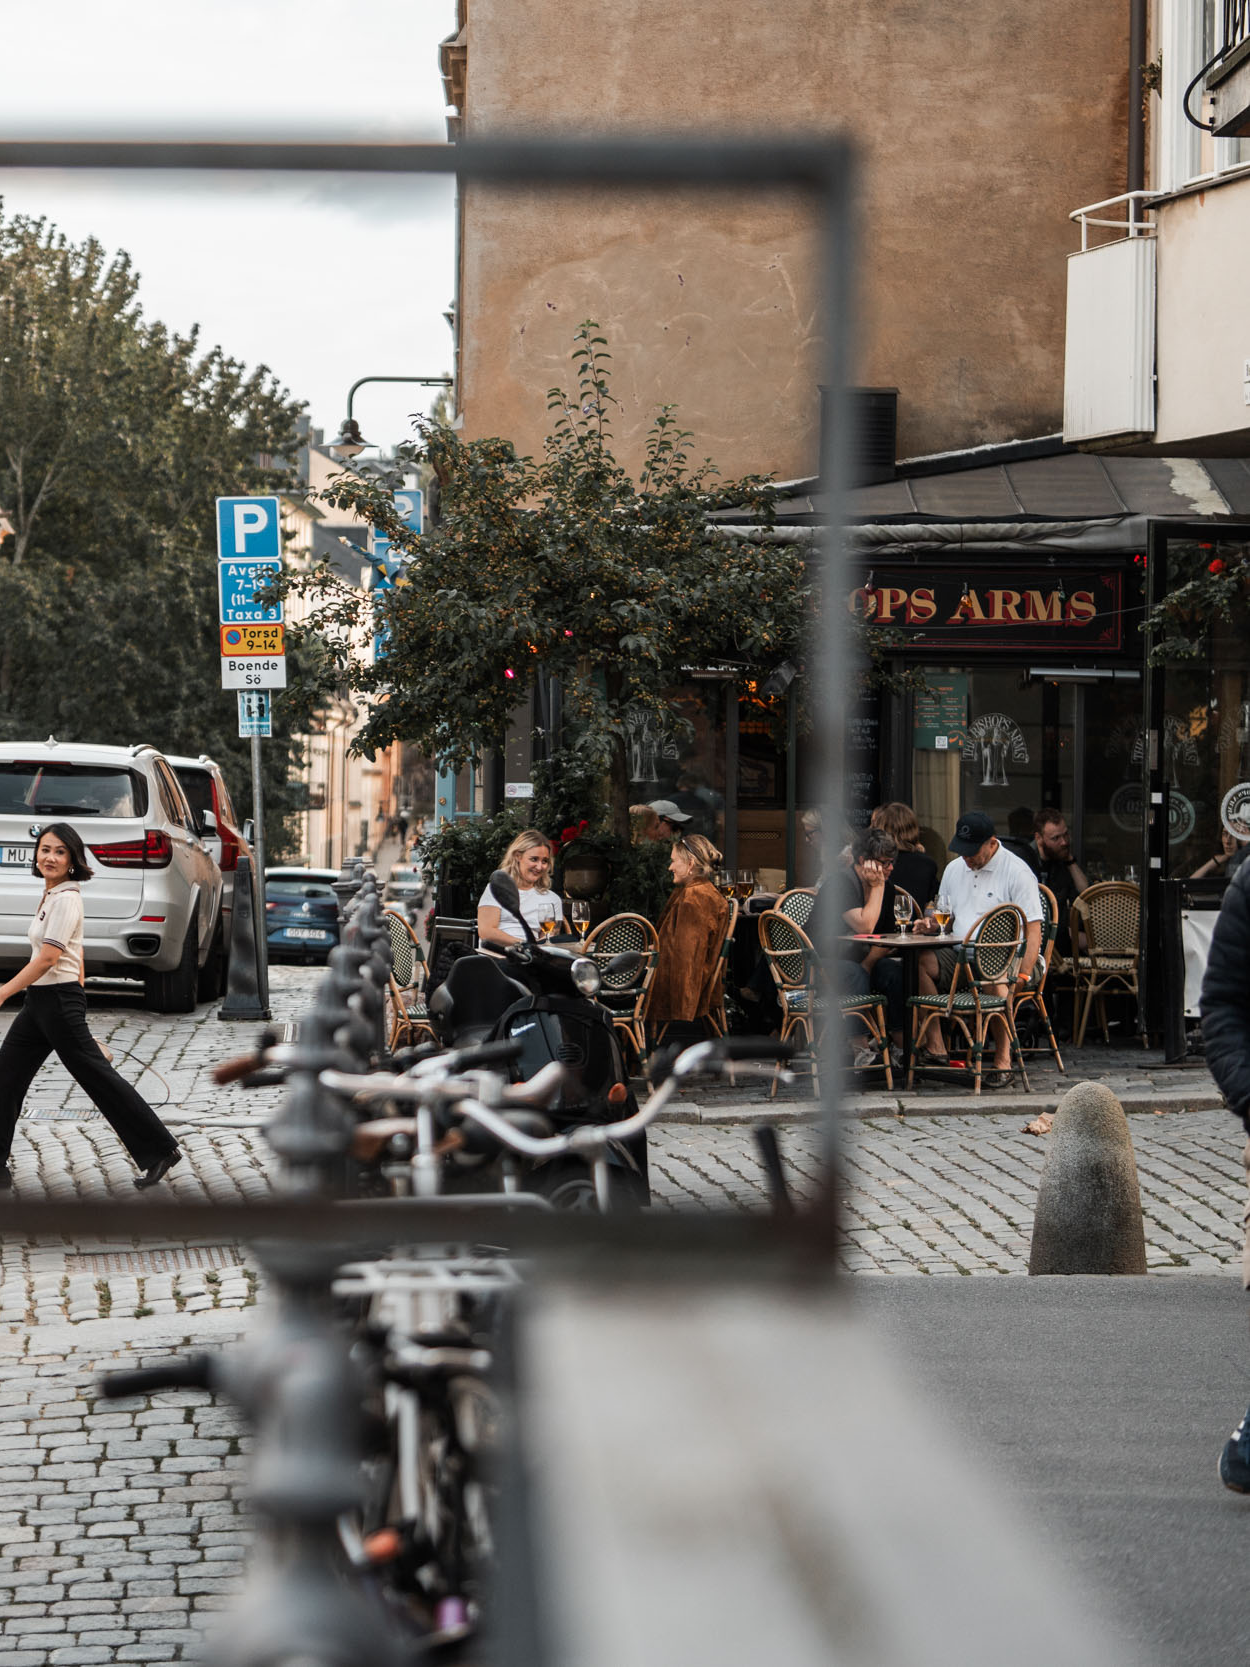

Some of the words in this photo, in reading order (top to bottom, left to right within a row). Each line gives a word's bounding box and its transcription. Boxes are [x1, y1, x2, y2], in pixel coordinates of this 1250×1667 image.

[233, 504, 268, 553] P
[231, 593, 264, 606] (11-
[948, 588, 1097, 624] ARMS
[226, 608, 263, 620] Taxa
[268, 608, 277, 619] 3
[241, 628, 278, 638] Torsd
[246, 640, 277, 650] 9-14
[229, 660, 278, 671] Boende
[245, 674, 261, 685] Sö
[970, 715, 1011, 738] BISHOPS
[1009, 728, 1025, 759] ARMS
